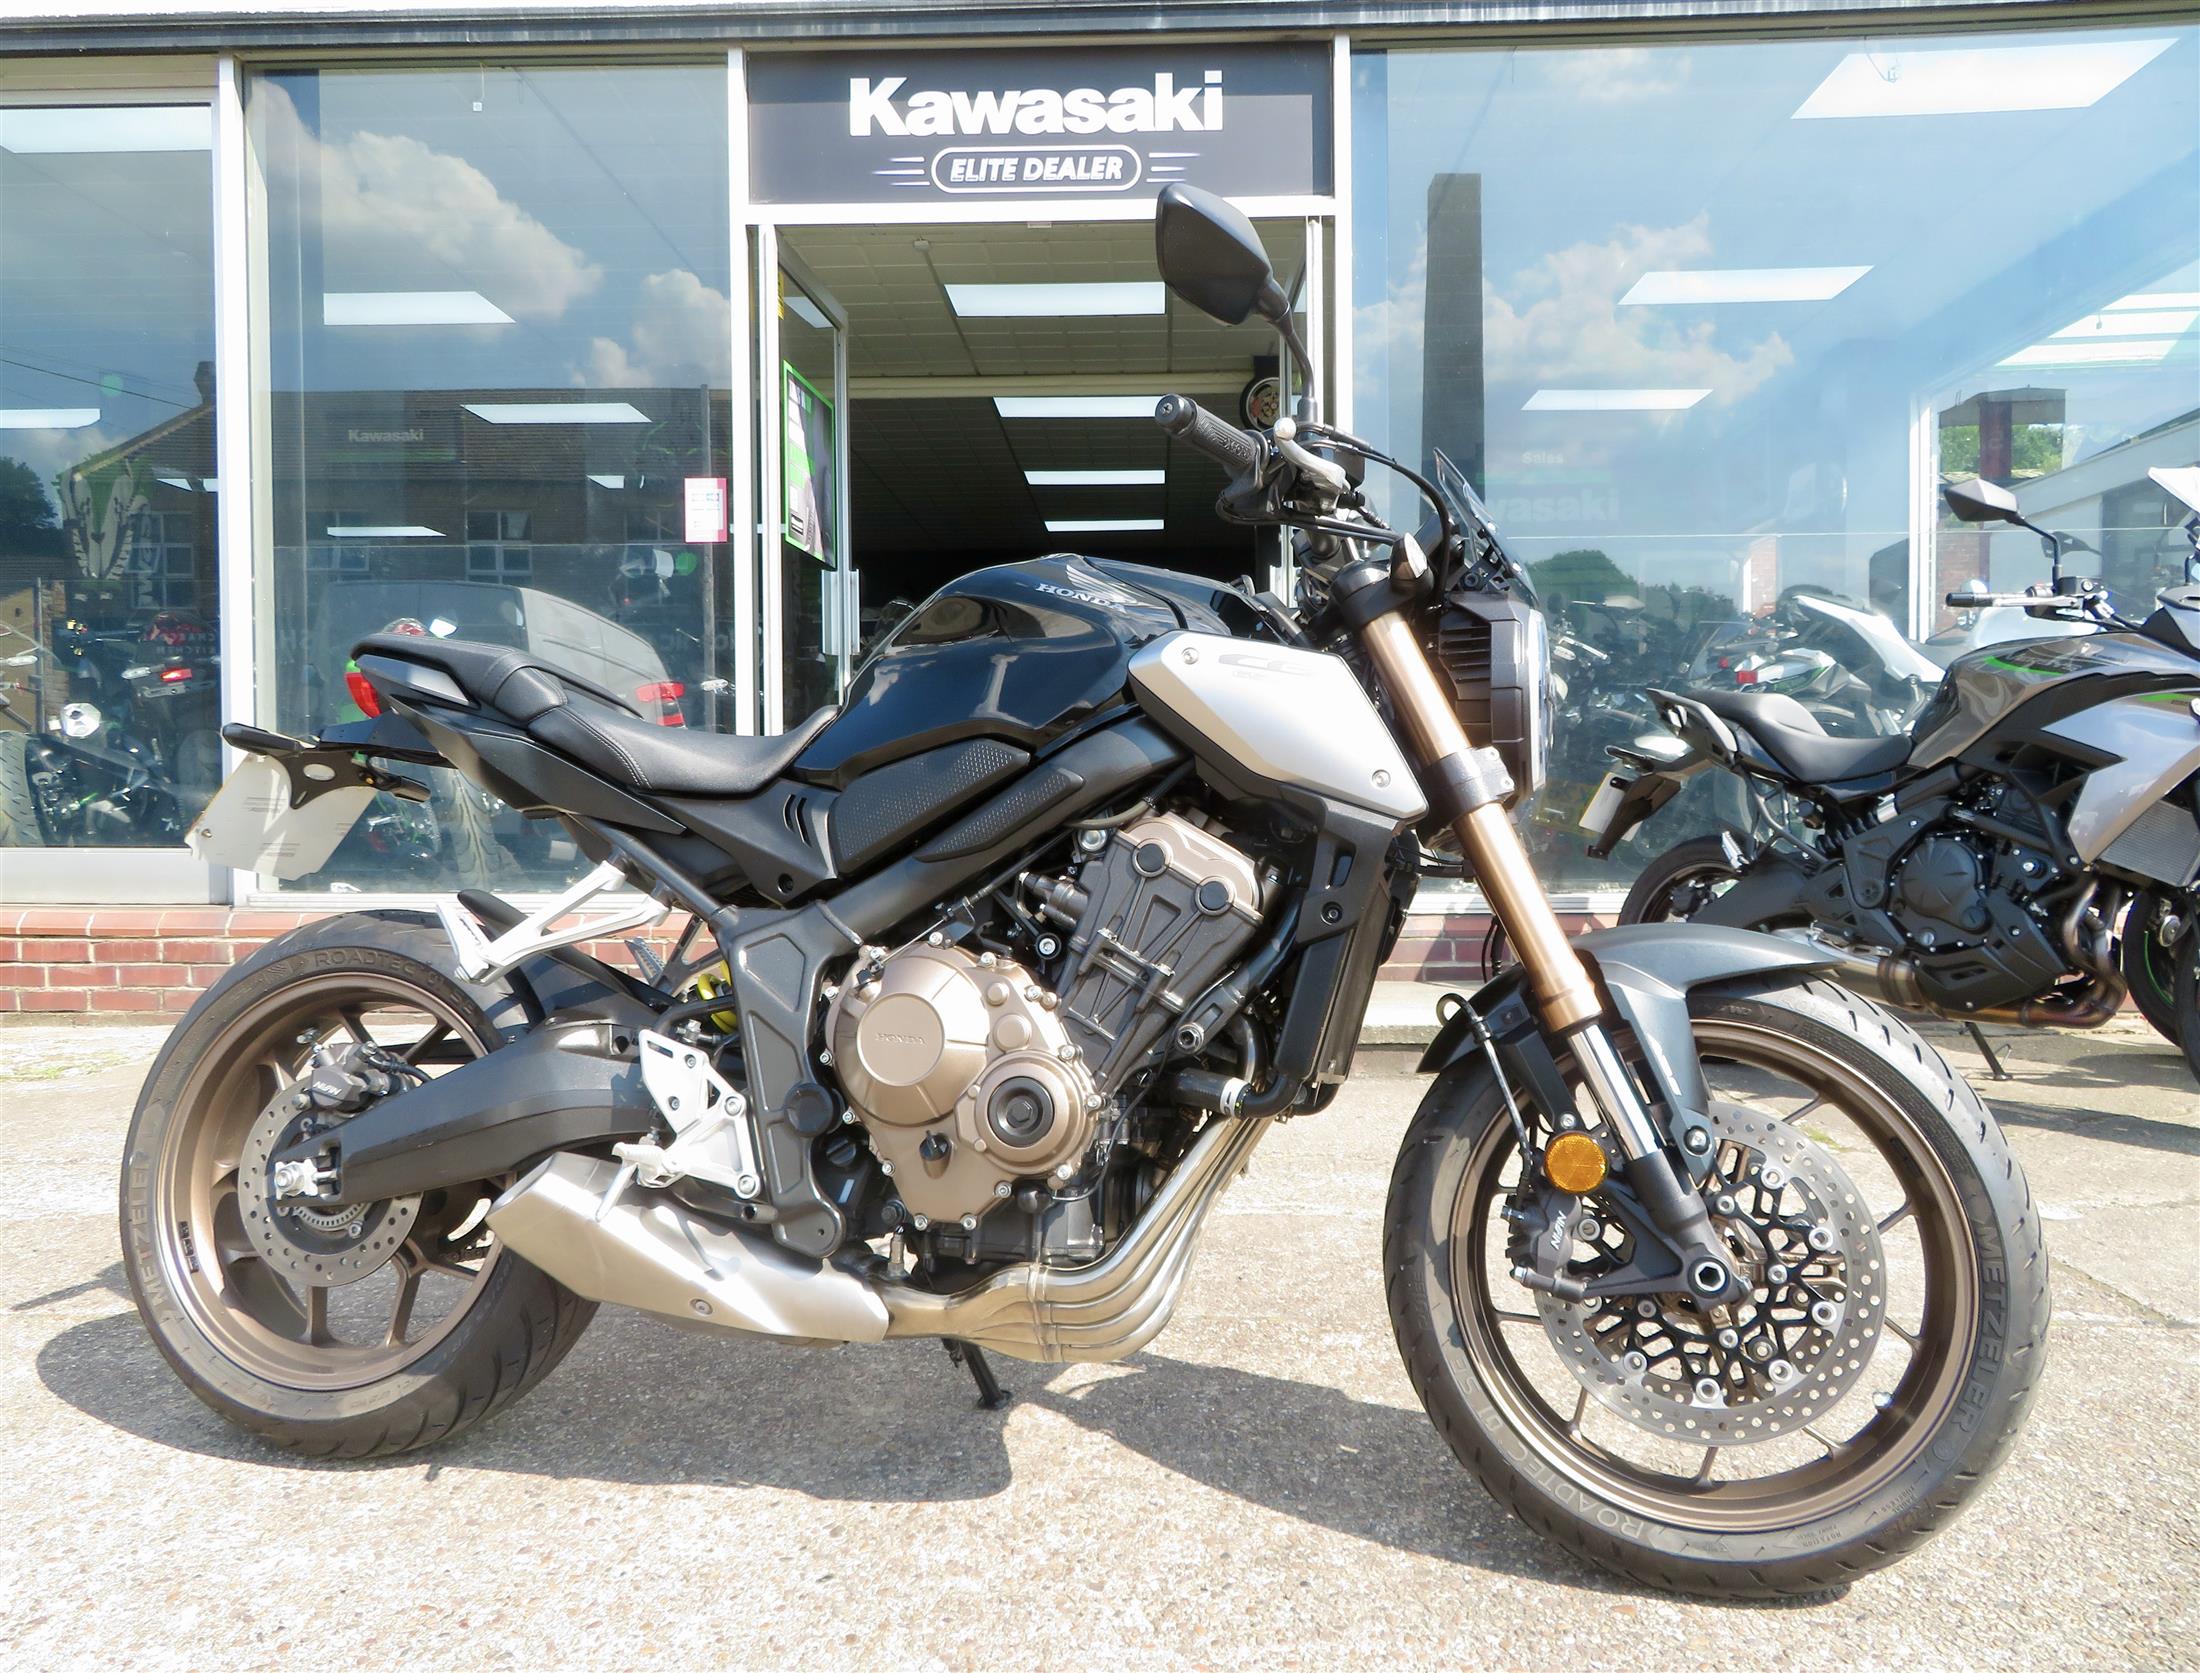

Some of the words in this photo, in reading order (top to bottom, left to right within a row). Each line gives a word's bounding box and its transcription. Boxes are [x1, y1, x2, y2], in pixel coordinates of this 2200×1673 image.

[850, 70, 1223, 136] Kawasaki
[950, 158, 1018, 182] ELITE
[1023, 156, 1123, 181] DEALER
[347, 428, 424, 442] Kawasaki
[1521, 451, 1565, 465] Sales
[1035, 583, 1127, 614] HONDA
[314, 950, 417, 977] ROADTEC
[875, 1032, 927, 1046] HONDA
[1950, 1217, 2007, 1433] METZELER
[1510, 1444, 1645, 1540] ROADTEC
